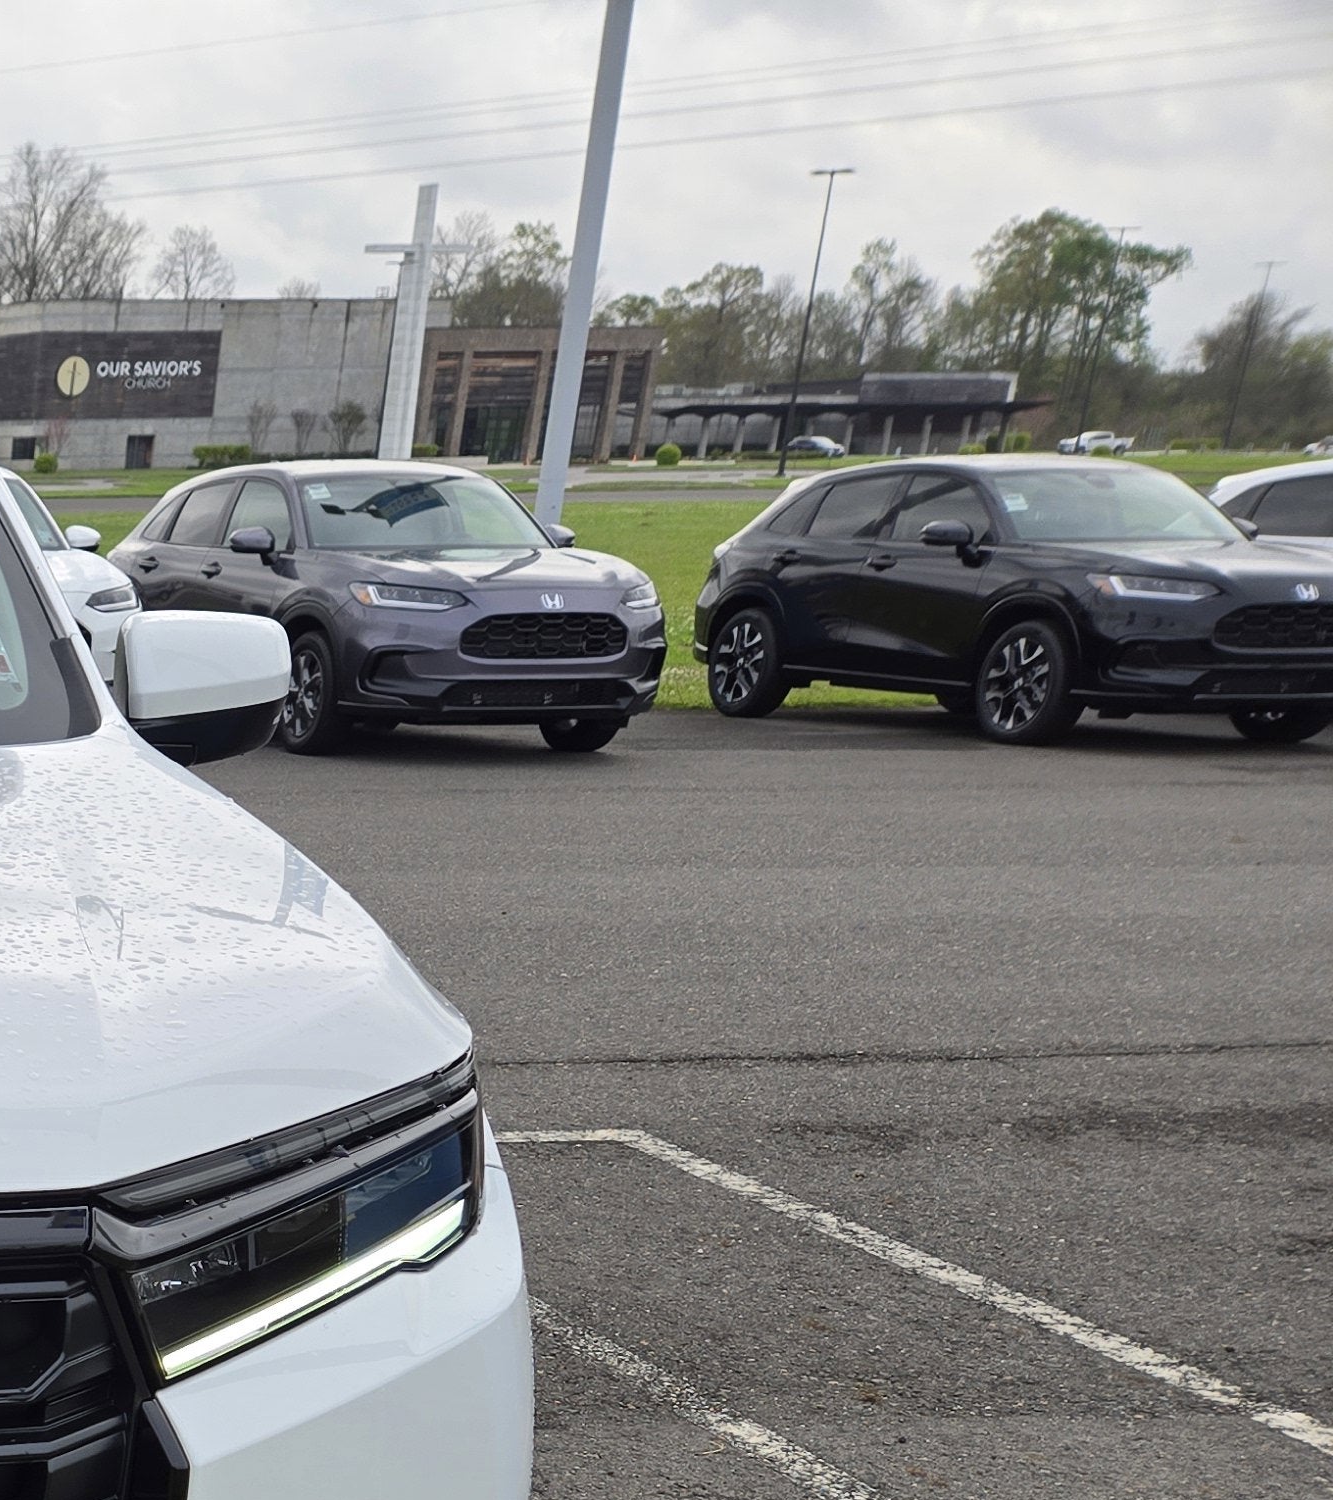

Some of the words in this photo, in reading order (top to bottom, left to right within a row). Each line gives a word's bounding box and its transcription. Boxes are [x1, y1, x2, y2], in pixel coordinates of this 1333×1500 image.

[96, 361, 130, 377] OUR
[134, 360, 202, 376] SAVIOR'S
[124, 377, 171, 389] CHURCH
